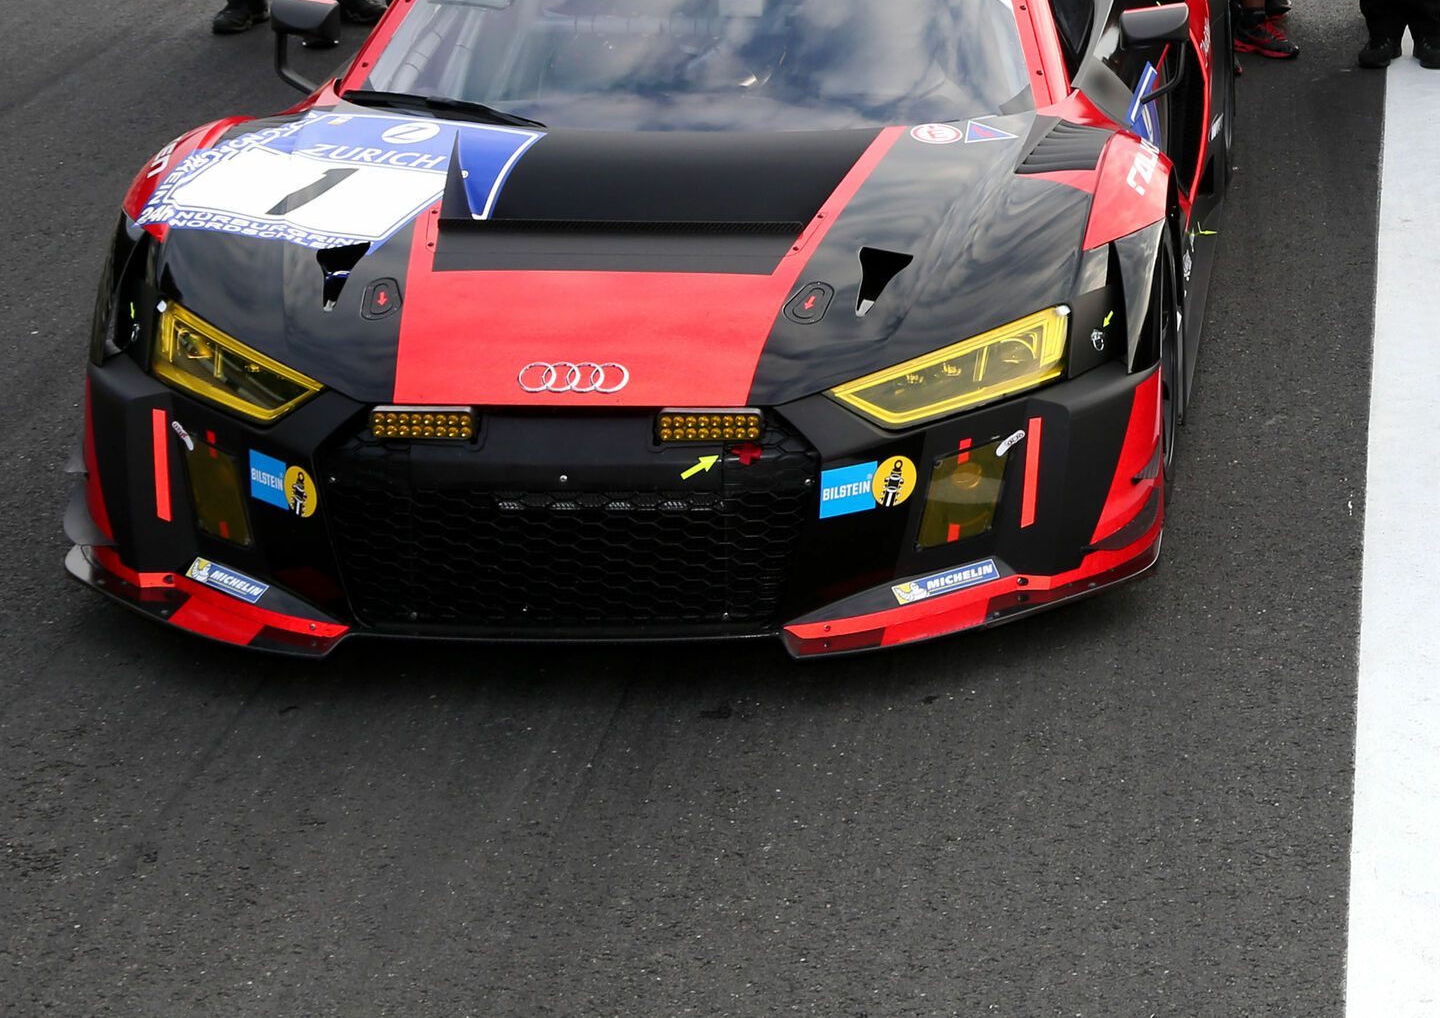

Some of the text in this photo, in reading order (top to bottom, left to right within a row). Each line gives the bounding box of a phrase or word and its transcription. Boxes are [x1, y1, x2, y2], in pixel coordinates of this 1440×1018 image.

[309, 142, 447, 170] ZURICH
[265, 167, 360, 216] 1
[209, 569, 264, 598] MICHELIN
[926, 563, 995, 591] MICHELIN
